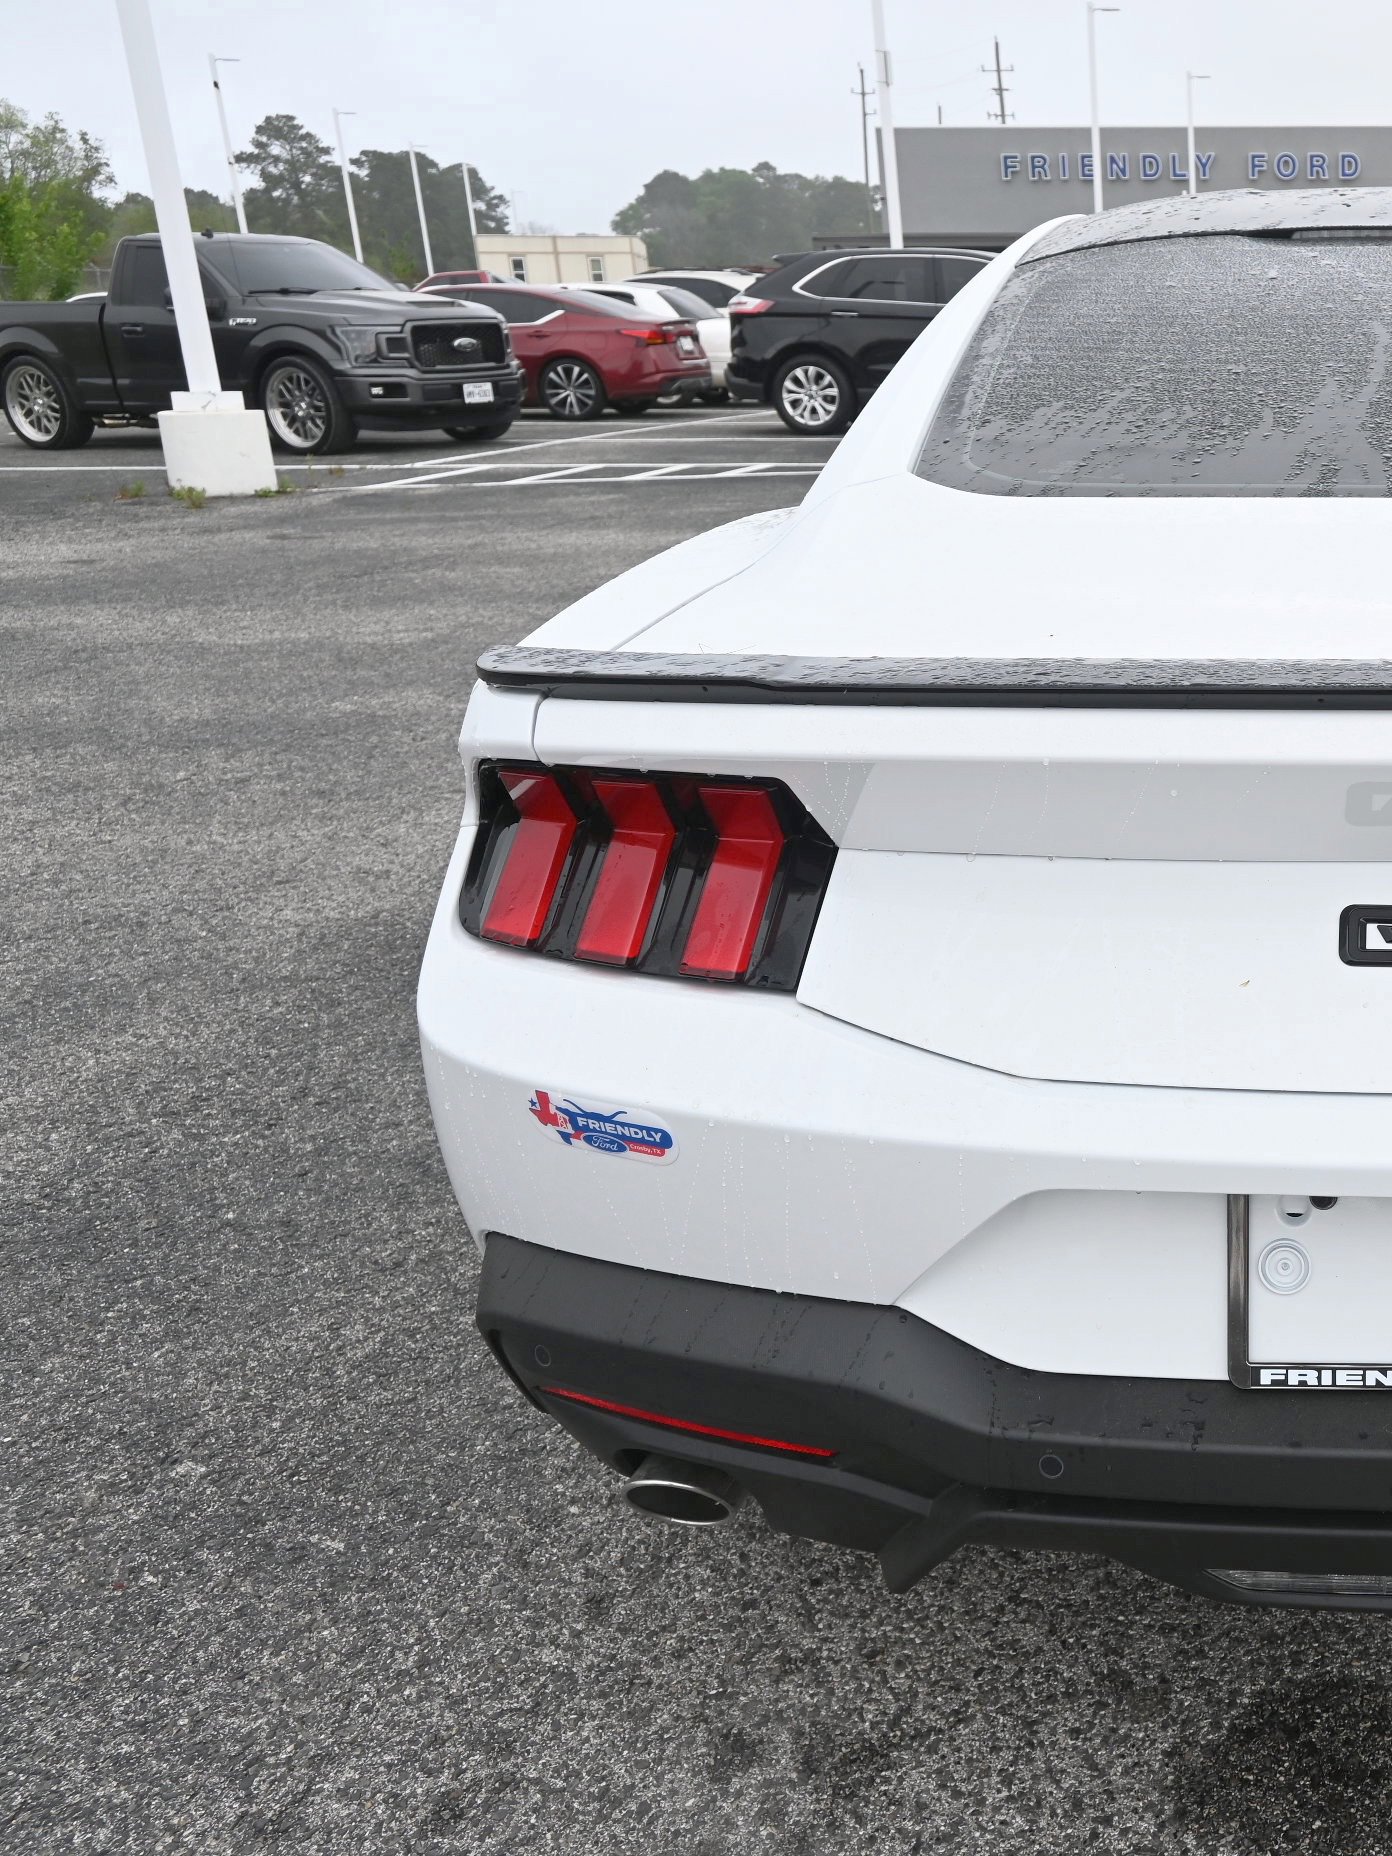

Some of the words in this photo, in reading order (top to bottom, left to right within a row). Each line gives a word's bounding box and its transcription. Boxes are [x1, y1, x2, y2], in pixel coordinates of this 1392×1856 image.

[1001, 152, 1216, 181] FRIENDLY
[1248, 152, 1361, 181] FORD
[576, 1116, 662, 1143] FRIENDLY
[591, 1135, 618, 1151] Ford
